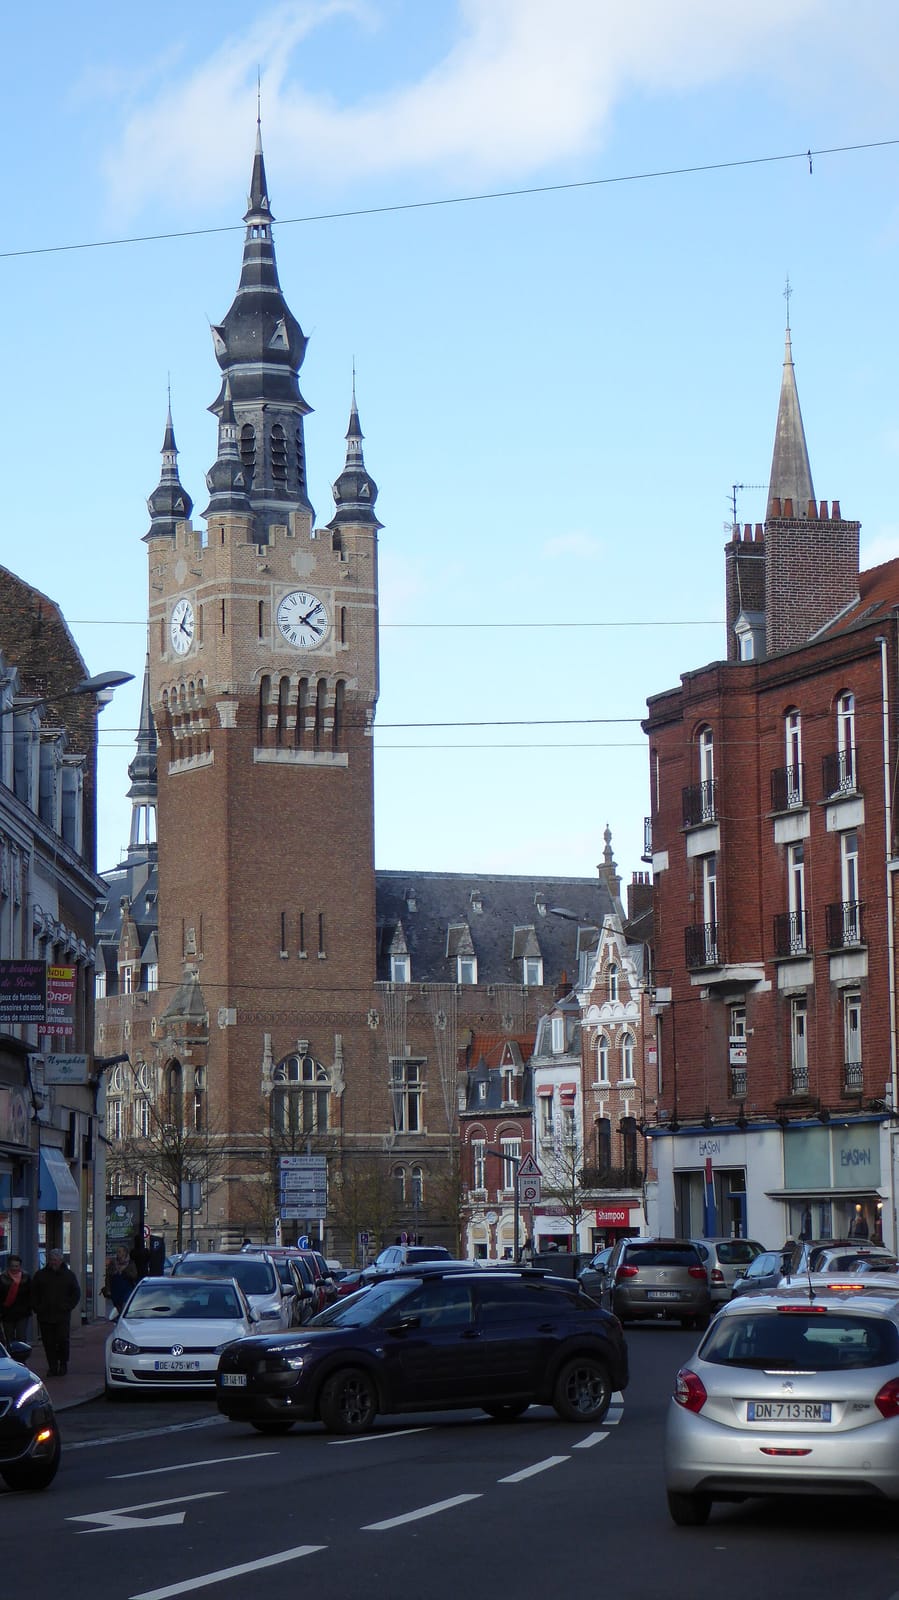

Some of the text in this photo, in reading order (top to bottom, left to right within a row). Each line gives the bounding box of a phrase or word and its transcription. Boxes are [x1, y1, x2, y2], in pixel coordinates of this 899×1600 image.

[47, 991, 72, 1002] ORPI
[30, 1003, 45, 1011] mode
[598, 1211, 625, 1223] Shampoo
